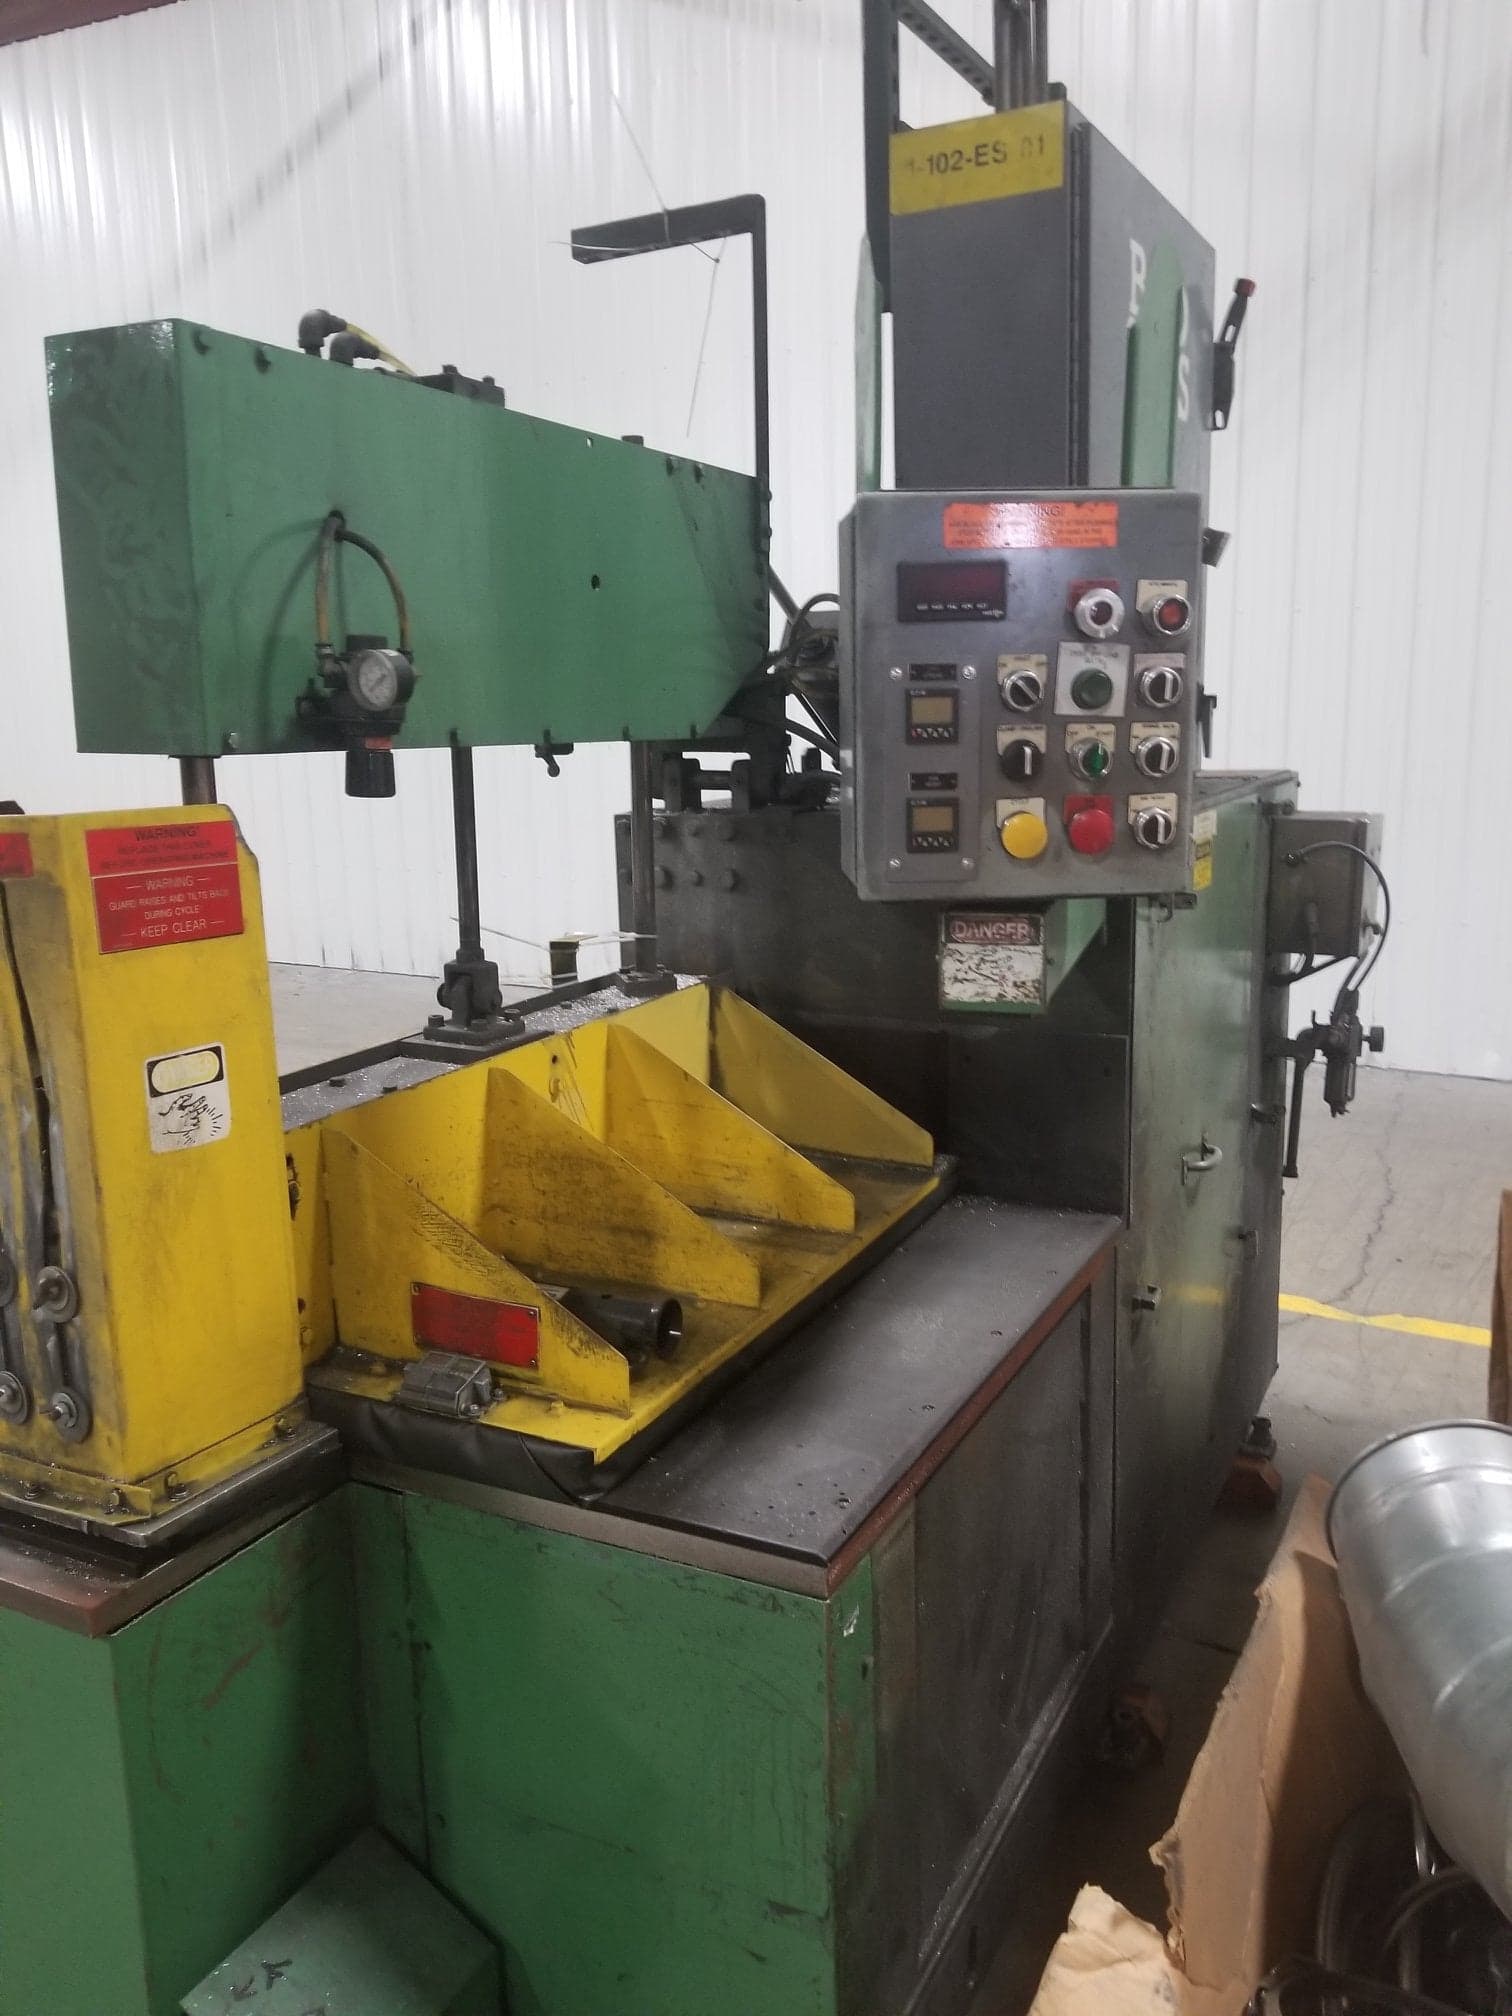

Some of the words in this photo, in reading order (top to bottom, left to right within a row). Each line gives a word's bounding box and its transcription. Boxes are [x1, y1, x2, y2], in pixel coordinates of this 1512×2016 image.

[145, 876, 194, 890] WARNING
[144, 907, 173, 920] DURING
[175, 905, 200, 916] CYCLE
[140, 925, 169, 938] KEEP
[172, 919, 207, 934] CLEAR
[954, 921, 1029, 939] DANGER
